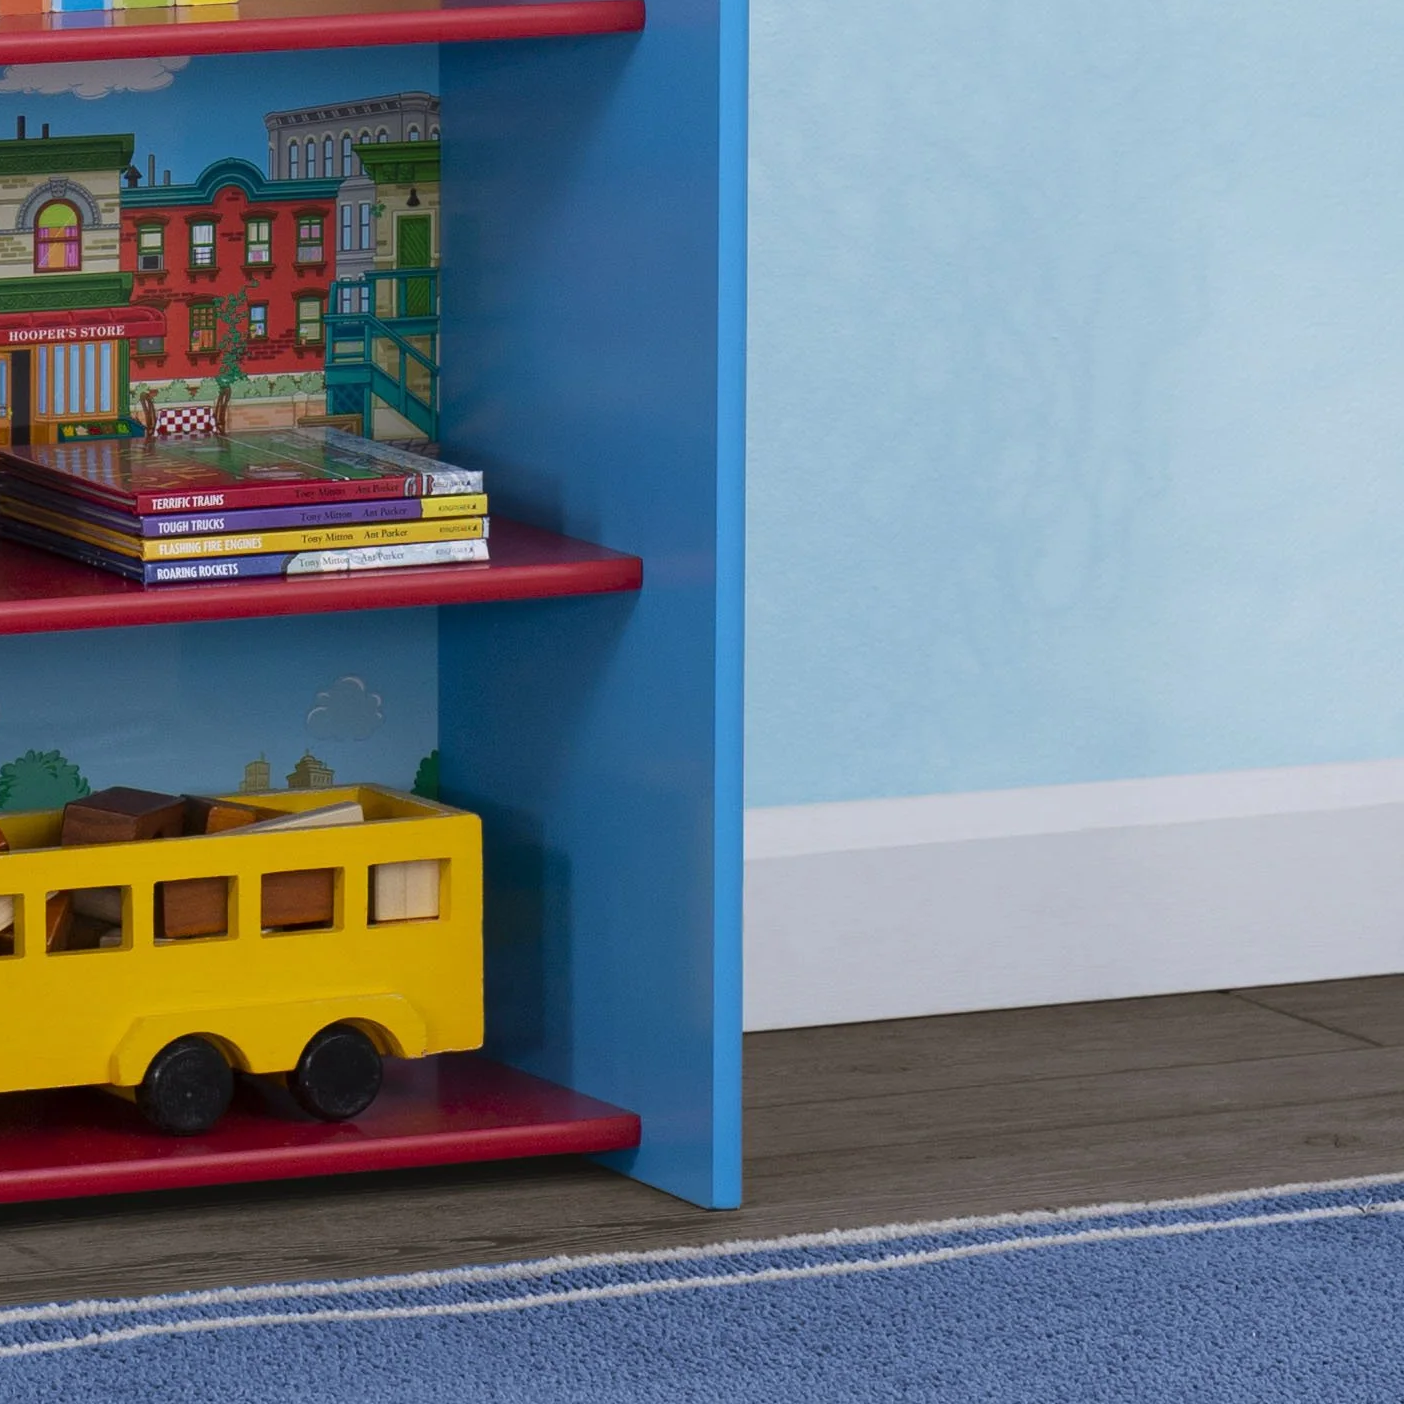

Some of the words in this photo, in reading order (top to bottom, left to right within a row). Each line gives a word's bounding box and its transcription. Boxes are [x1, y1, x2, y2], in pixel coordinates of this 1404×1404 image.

[8, 328, 78, 342] HOOPER'S
[80, 324, 126, 338] STORE
[151, 497, 191, 511] TERRIFIC
[192, 493, 225, 507] TRAINS
[157, 521, 189, 534] TOUGH
[191, 517, 225, 532] TRUCKS
[158, 541, 201, 556] FLASHING
[203, 539, 223, 553] FIRE
[225, 536, 263, 551] ENGINES
[156, 564, 197, 581] ROARING
[198, 562, 239, 577] ROCKETS
